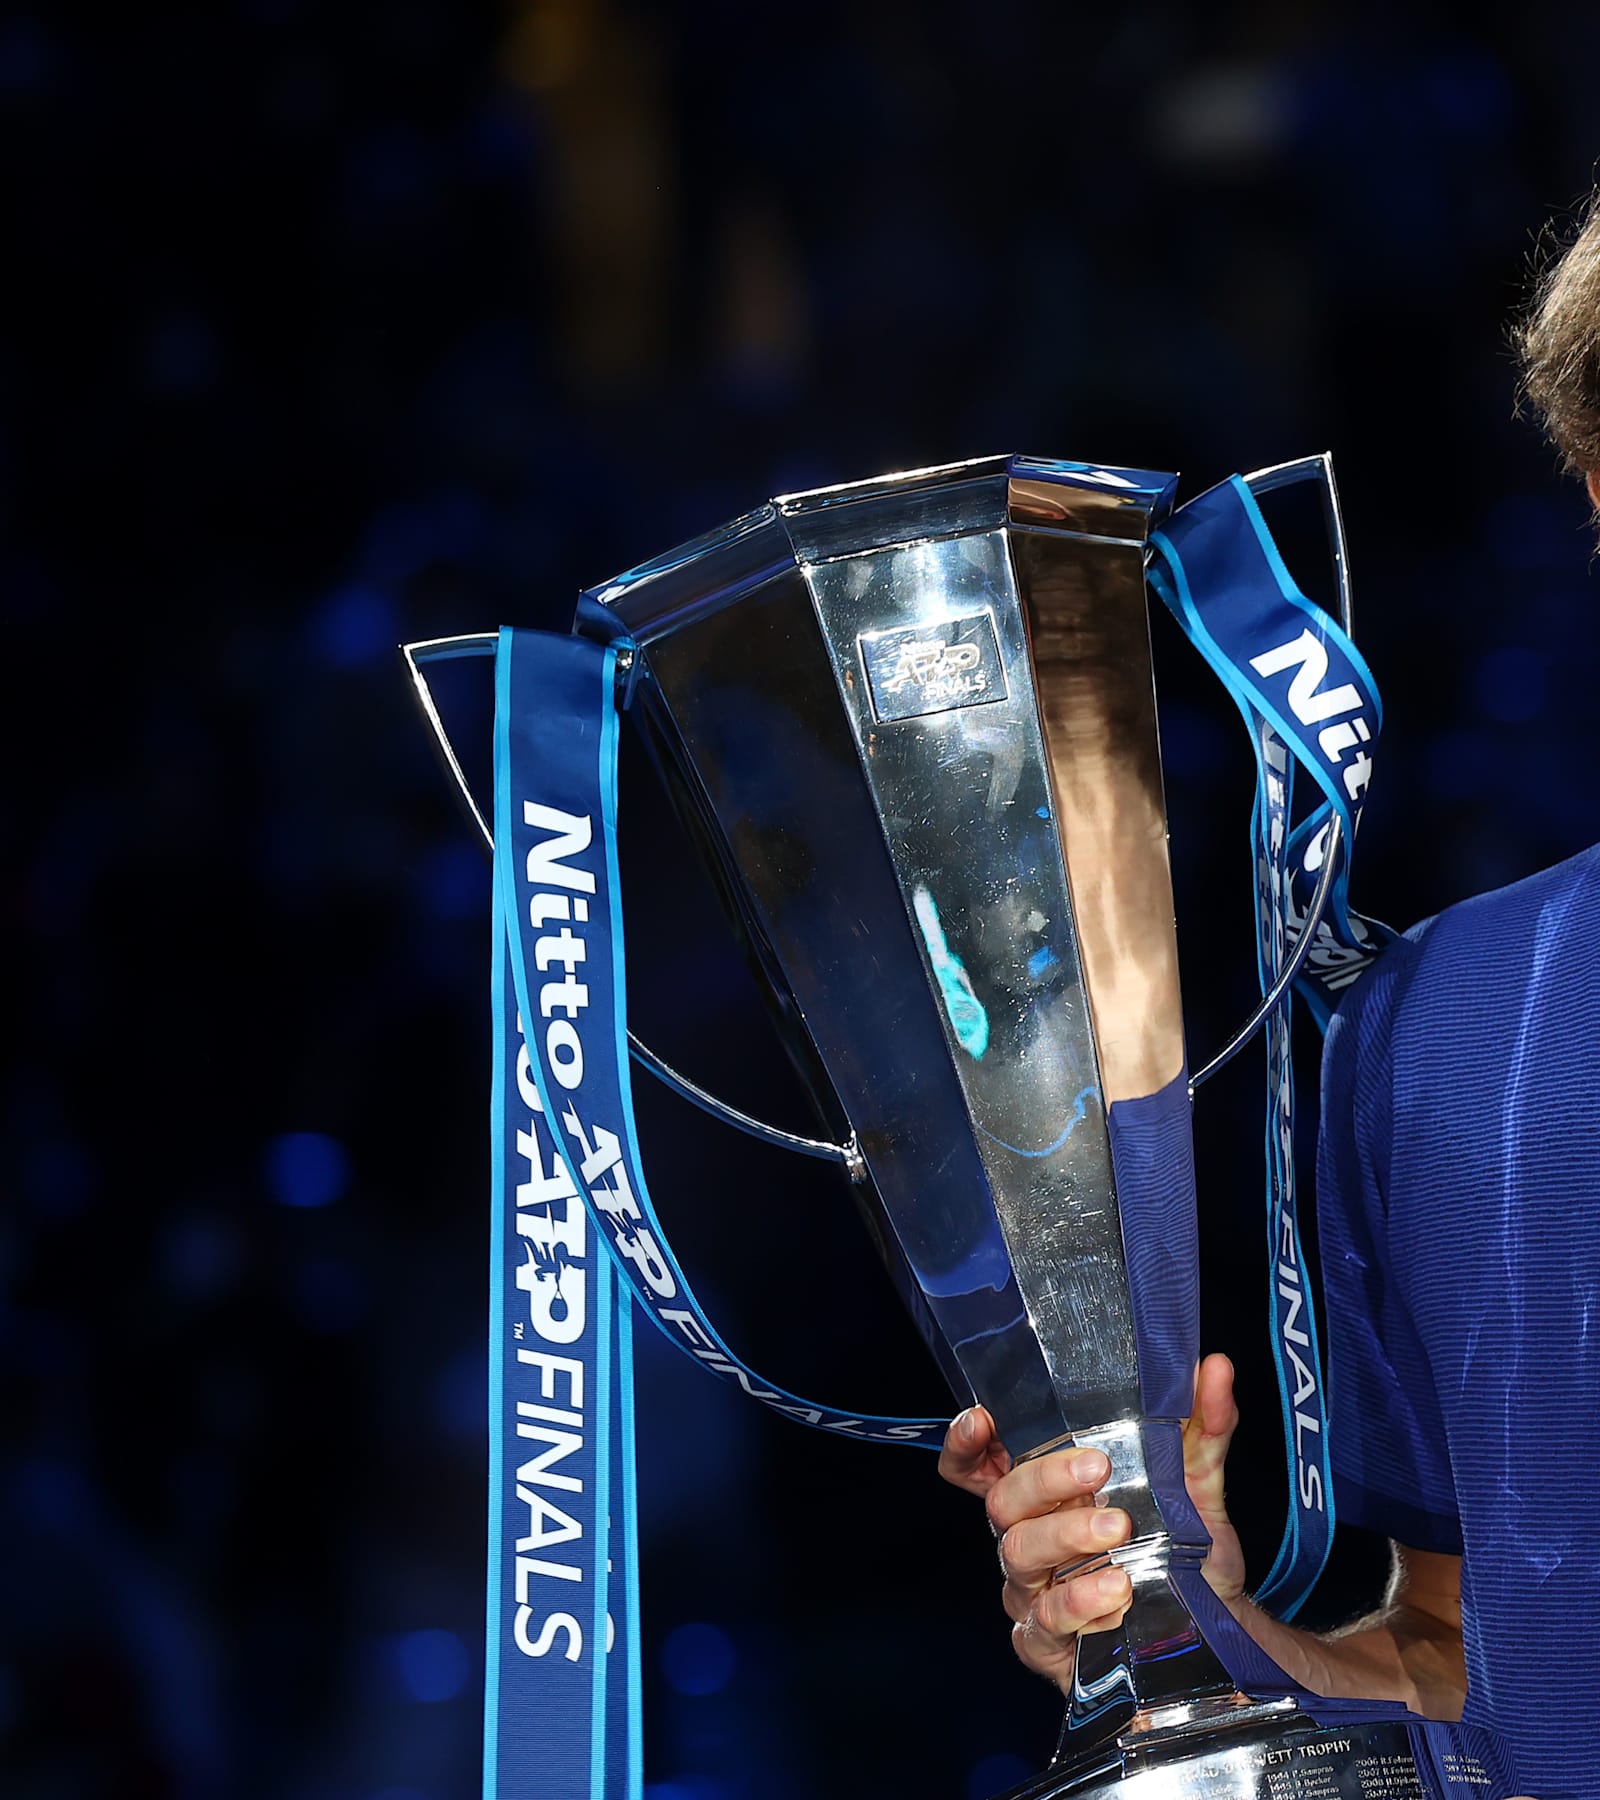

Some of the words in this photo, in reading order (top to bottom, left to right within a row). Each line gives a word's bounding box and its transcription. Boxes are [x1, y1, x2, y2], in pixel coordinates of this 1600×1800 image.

[516, 1117, 586, 1344] ATP
[522, 800, 596, 1090] Nitto
[562, 1098, 677, 1299] ATP
[657, 1308, 938, 1440] FINALS
[514, 1349, 584, 1662] FINALS
[1278, 1210, 1323, 1512] FINALS
[1297, 1741, 1351, 1758] TROPHY
